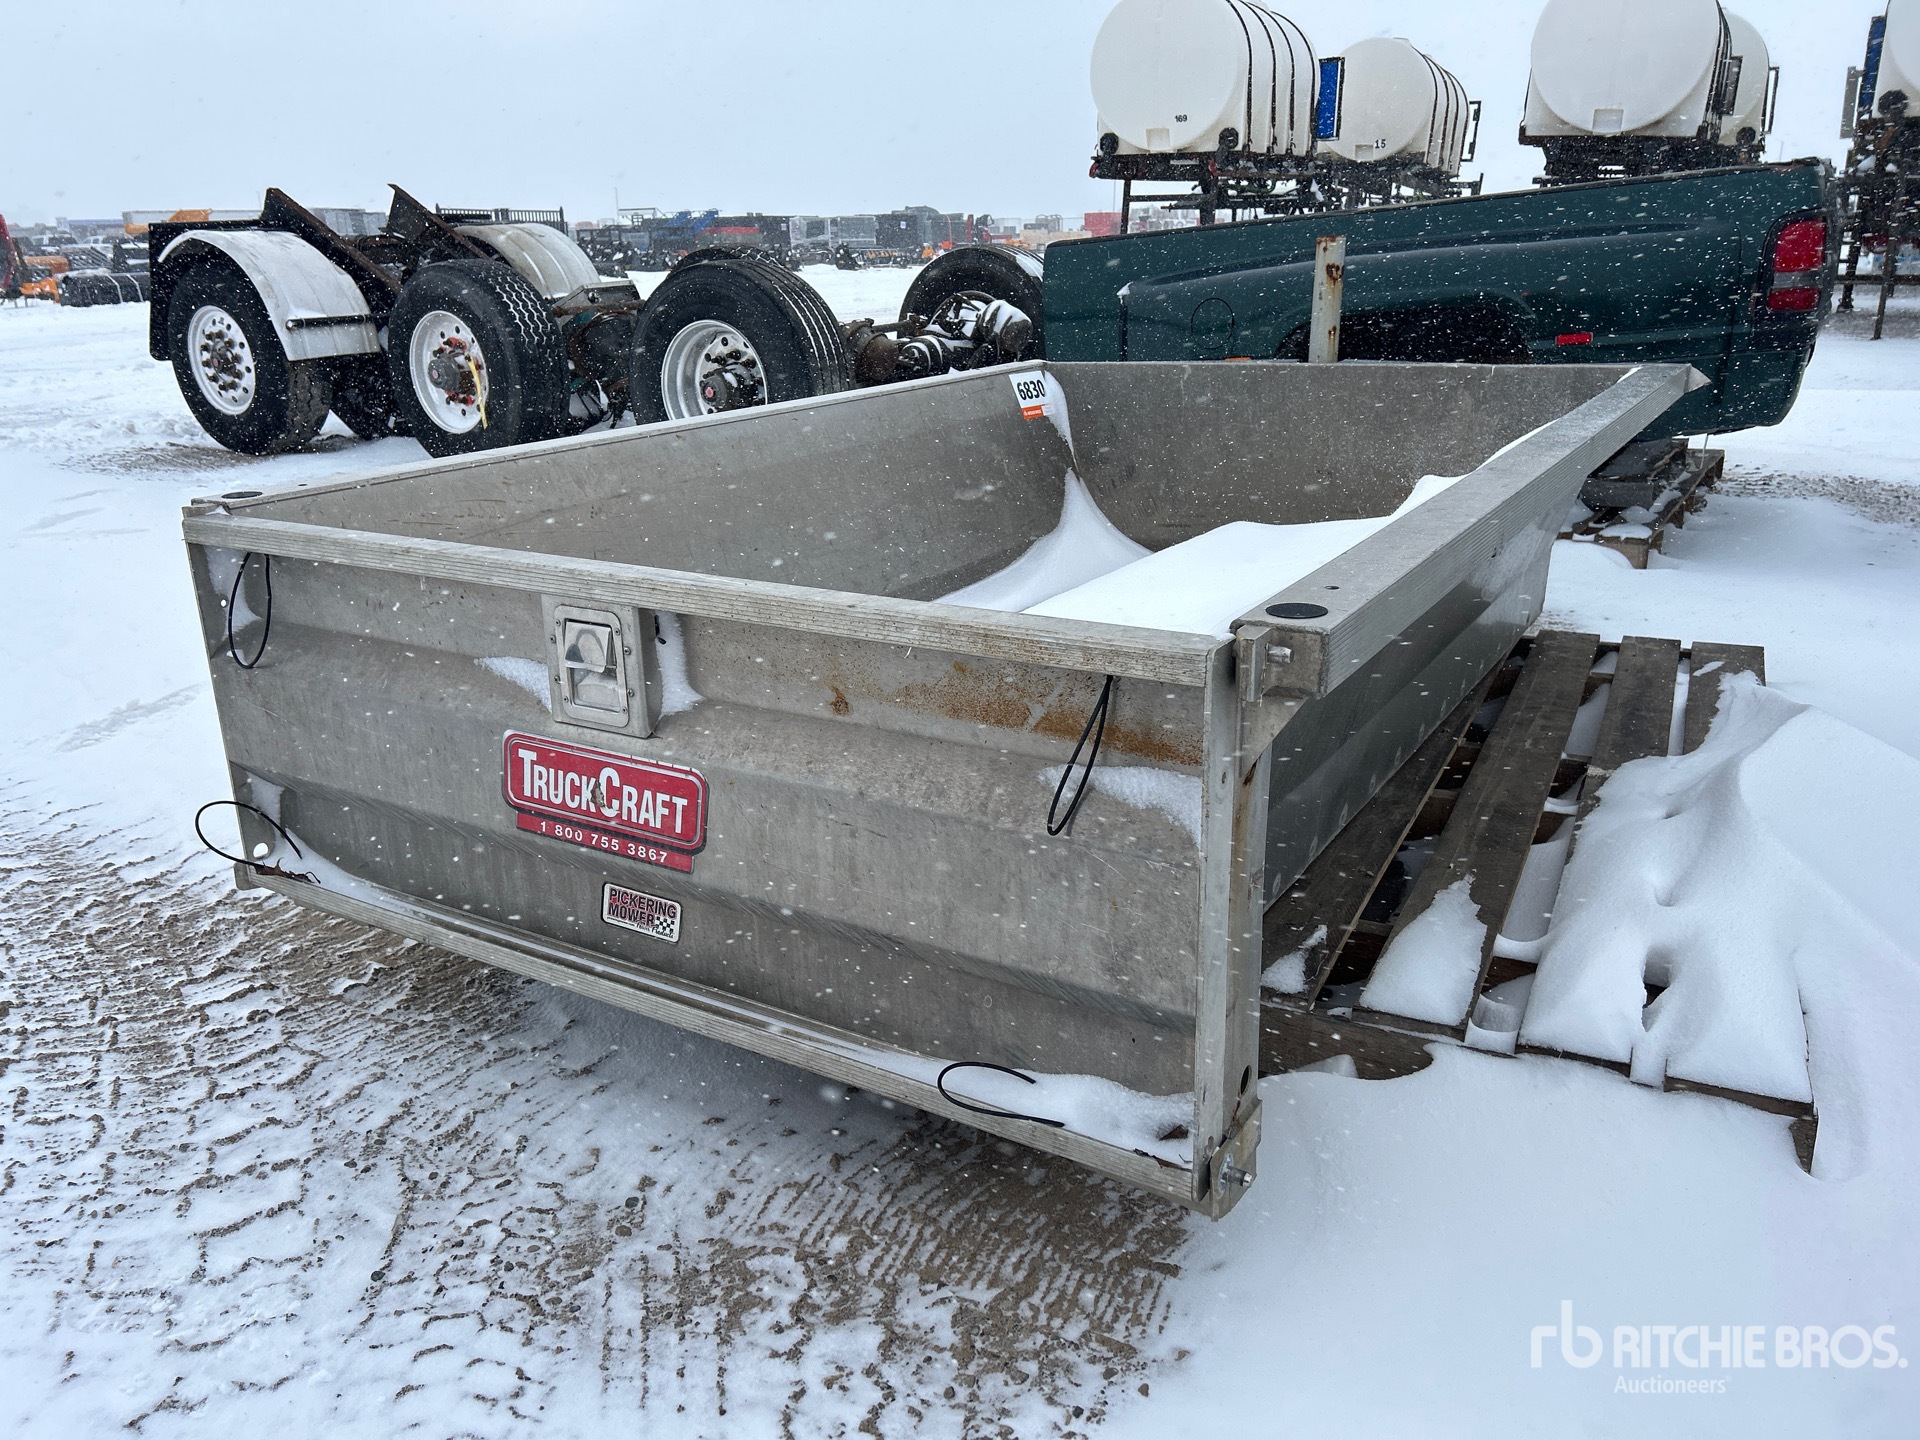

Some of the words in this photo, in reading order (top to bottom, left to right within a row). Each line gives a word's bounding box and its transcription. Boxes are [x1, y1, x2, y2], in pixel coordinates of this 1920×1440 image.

[1175, 115, 1188, 123] 169
[1375, 139, 1386, 149] 15
[1017, 380, 1046, 400] 6830
[540, 821, 547, 832] 1
[554, 825, 584, 842] 800
[591, 834, 620, 851] 755
[627, 843, 668, 864] 3867
[609, 888, 677, 919] PICKERING
[608, 904, 656, 928] MOWER
